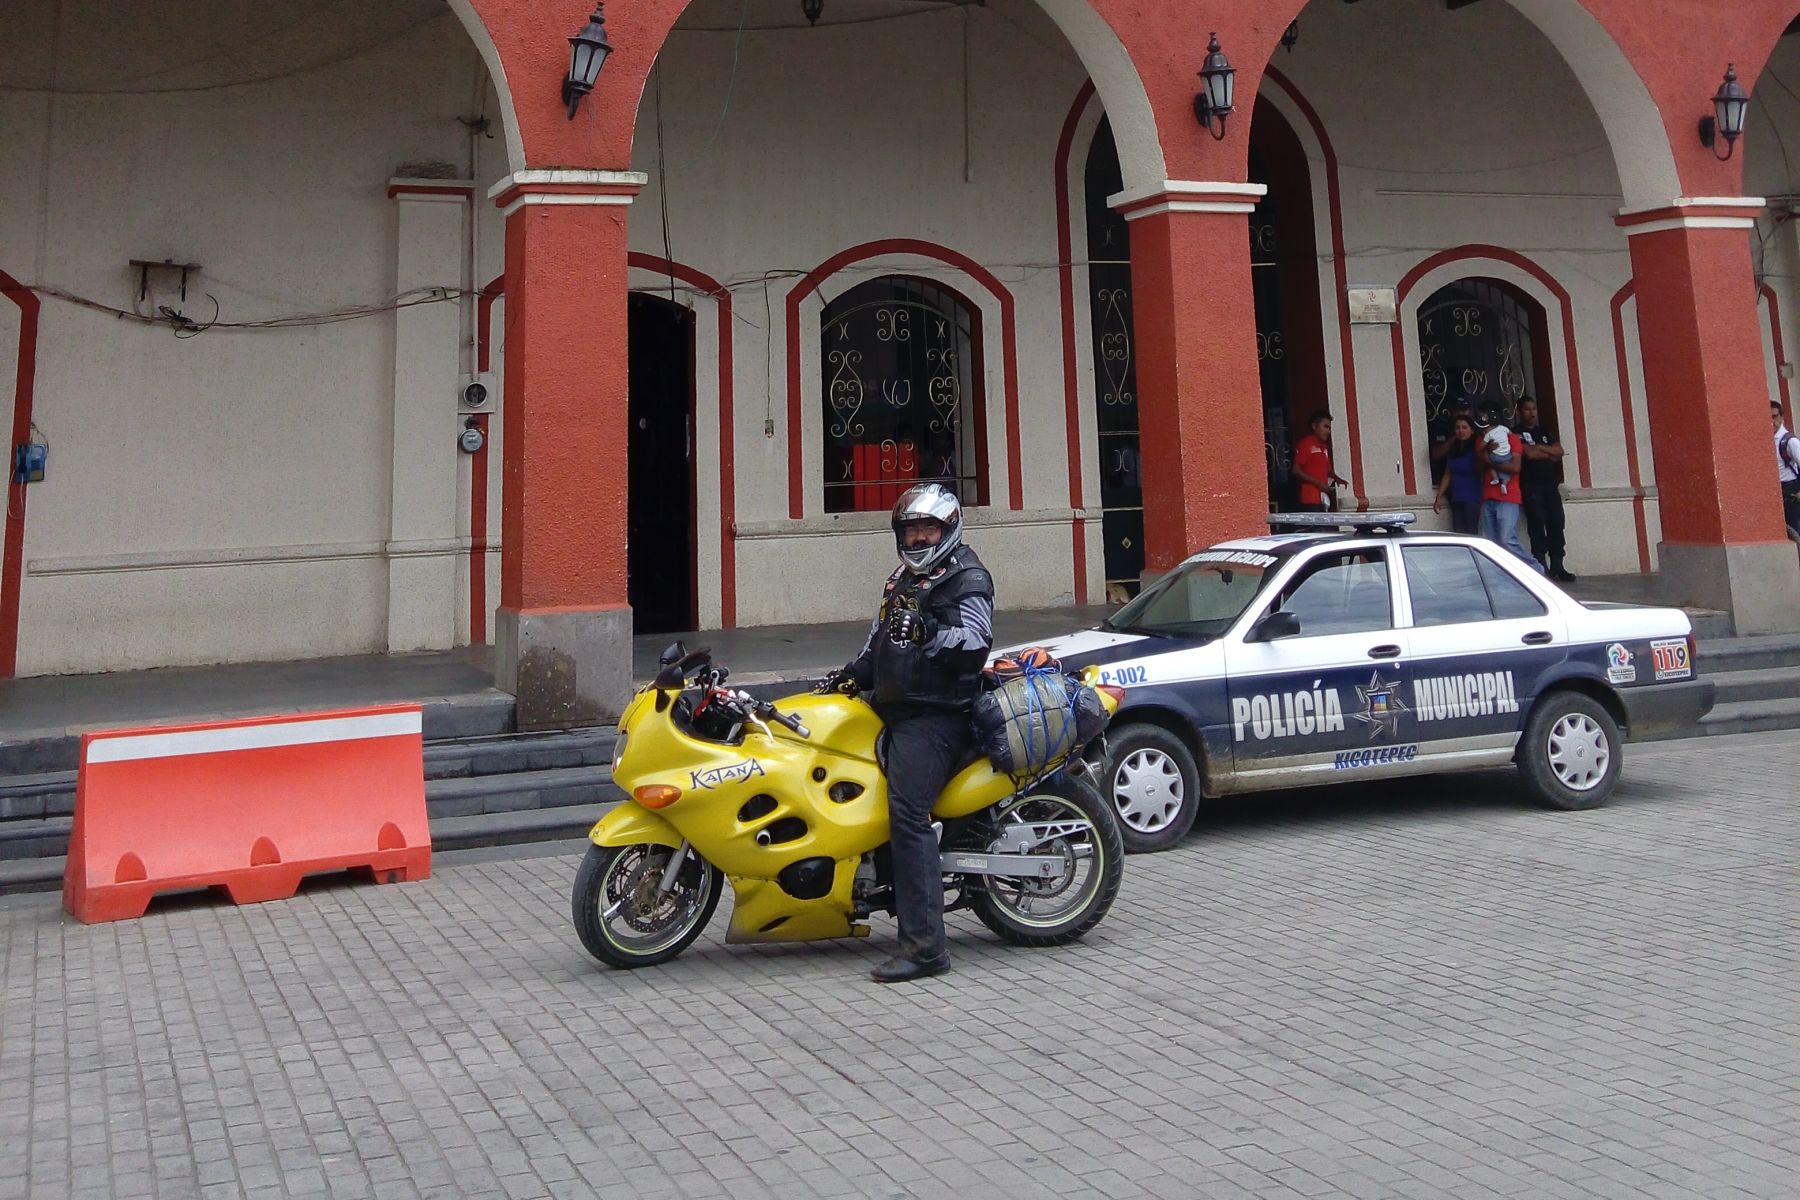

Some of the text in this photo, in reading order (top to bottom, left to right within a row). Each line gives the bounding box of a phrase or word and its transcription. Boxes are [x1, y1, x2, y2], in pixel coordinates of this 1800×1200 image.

[1655, 646, 1687, 670] 119
[1101, 665, 1148, 686] P-002
[1232, 670, 1520, 742] POLICÍA MUNICIPAL
